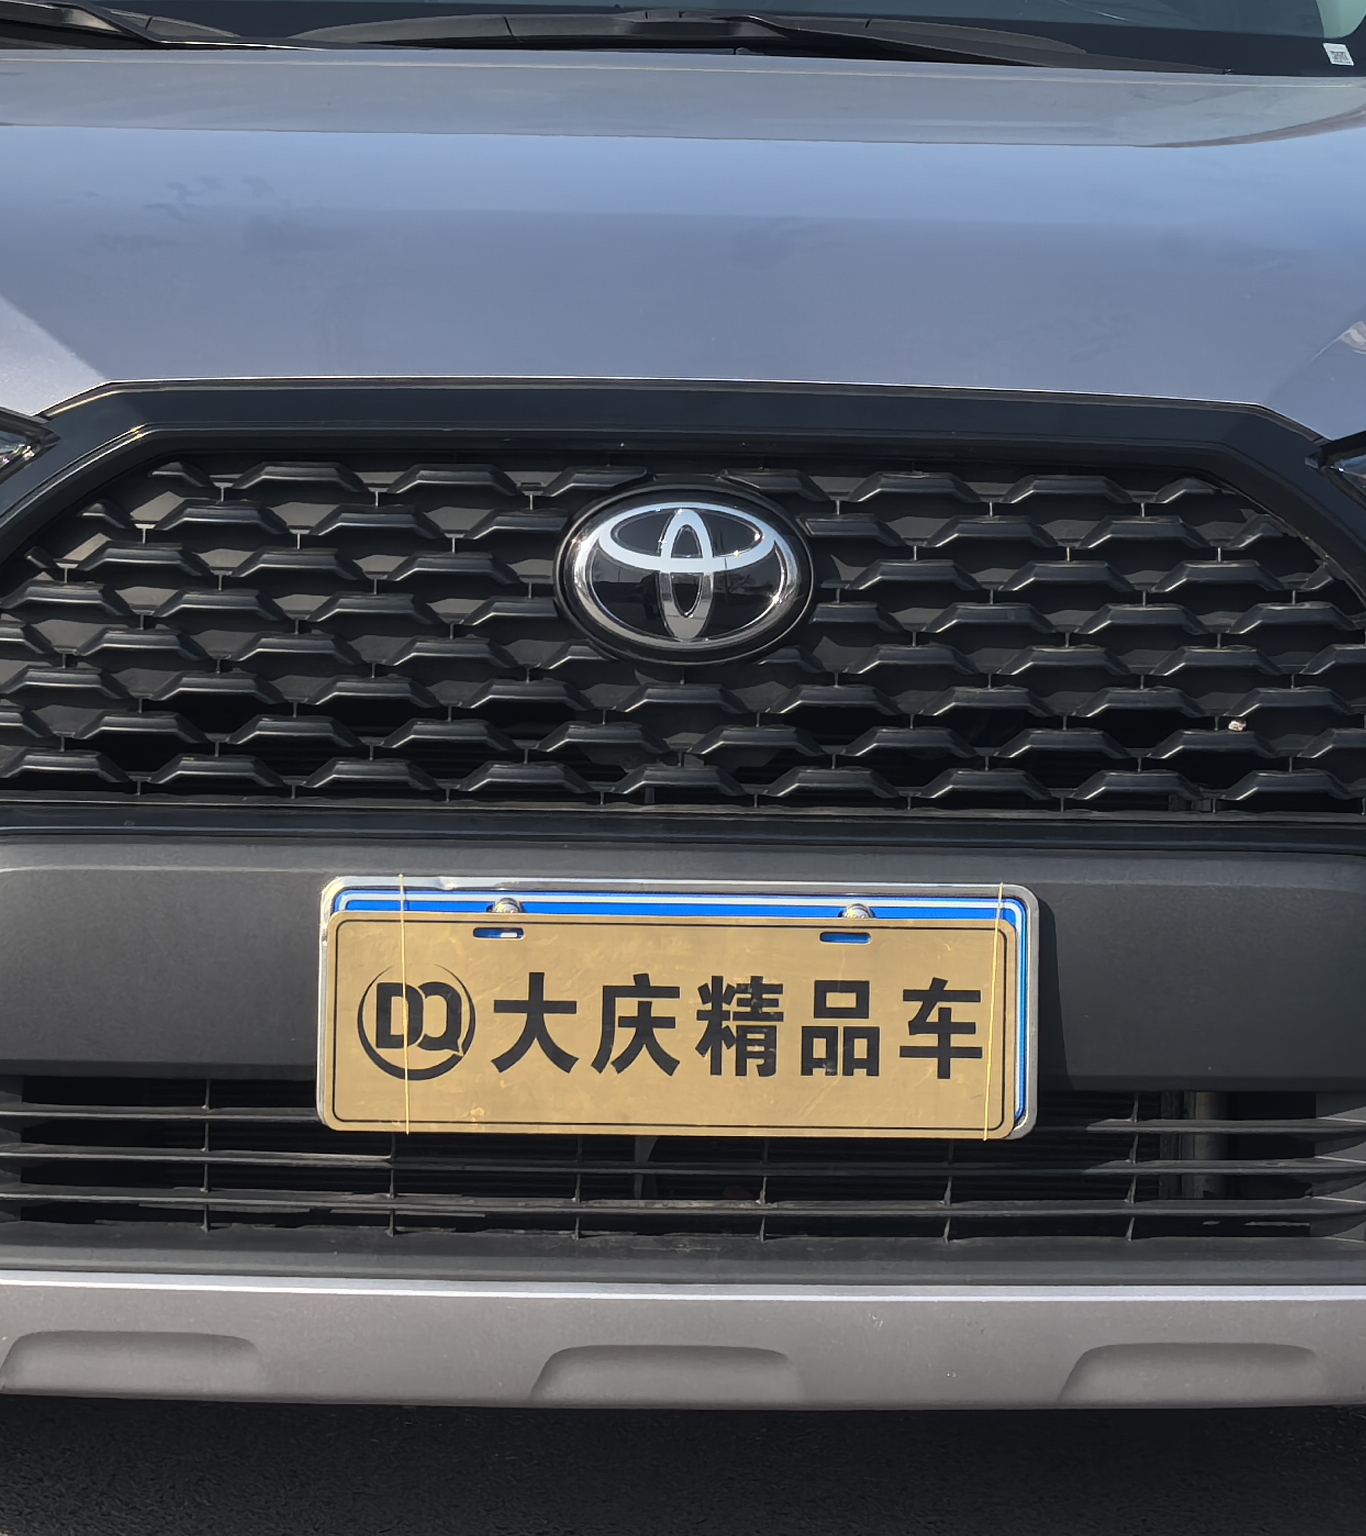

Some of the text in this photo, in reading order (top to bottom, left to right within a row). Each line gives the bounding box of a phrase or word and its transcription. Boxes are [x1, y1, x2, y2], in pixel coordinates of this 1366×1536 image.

[491, 971, 984, 1080] 大庆精品车
